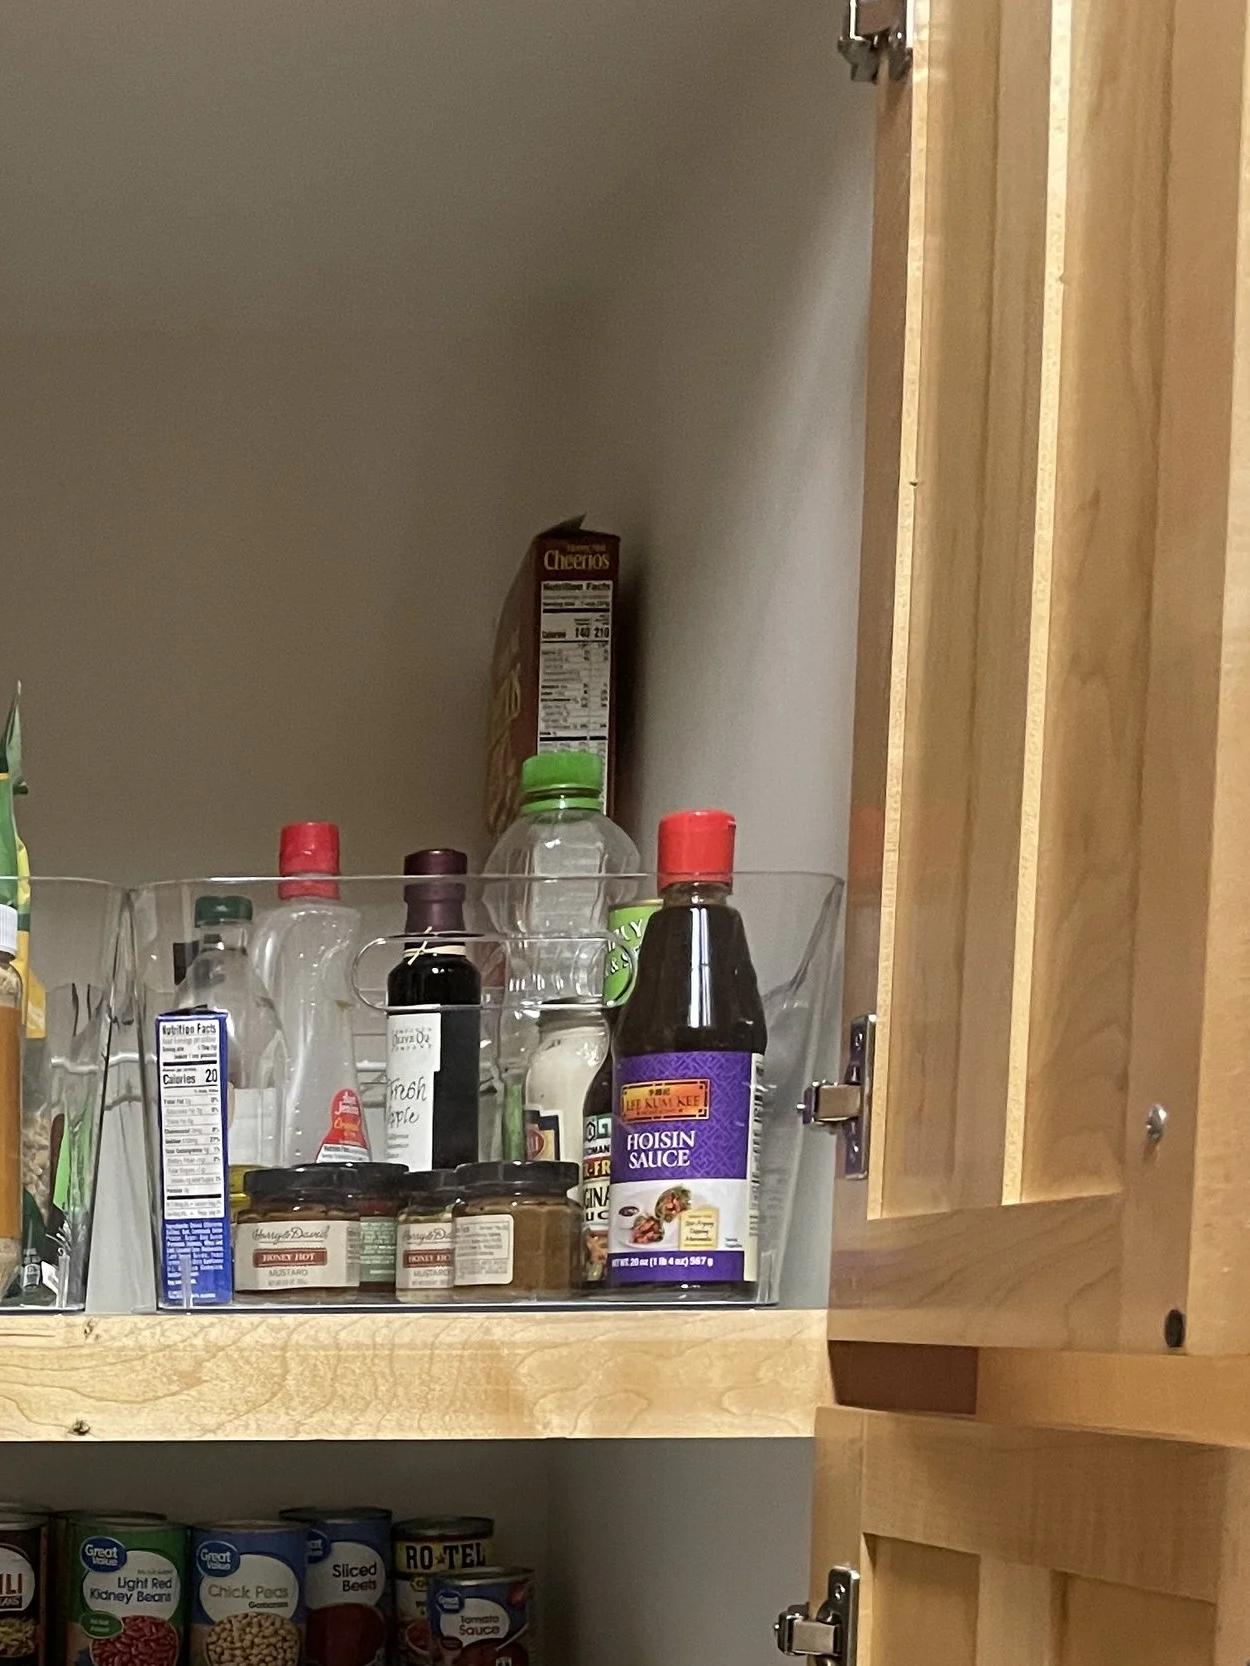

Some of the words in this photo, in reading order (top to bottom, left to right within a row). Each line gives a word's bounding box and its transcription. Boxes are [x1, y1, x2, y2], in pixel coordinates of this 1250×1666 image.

[544, 550, 610, 570] Cheerios
[162, 1024, 195, 1036] Nutrition
[197, 1023, 217, 1034] Facts
[163, 1074, 196, 1085] Calories
[205, 1069, 218, 1082] 20
[626, 1099, 641, 1111] LEE
[645, 1098, 671, 1108] KUM
[677, 1096, 700, 1107] KEE
[627, 1131, 696, 1152] HOISIN
[629, 1151, 690, 1169] SAUCE
[263, 1254, 293, 1262] HONEY
[295, 1253, 316, 1261] HOT
[630, 1258, 639, 1266] 20
[650, 1258, 657, 1267] (1
[675, 1258, 688, 1266] oz)
[690, 1257, 707, 1265] 567
[707, 1258, 713, 1267] g
[84, 1543, 119, 1560] Great
[200, 1549, 231, 1563] Great
[405, 1545, 433, 1570] RO
[443, 1543, 486, 1569] TEL
[92, 1557, 118, 1567] Value
[206, 1561, 231, 1570] Value
[333, 1563, 377, 1577] Sliced
[118, 1576, 148, 1591] Light
[151, 1576, 172, 1589] Red
[342, 1580, 377, 1591] Beets
[90, 1588, 132, 1604] Kidney
[136, 1590, 172, 1603] Beans
[208, 1584, 250, 1598] Chick
[256, 1585, 289, 1599] Peas
[460, 1616, 500, 1624] Tomato
[459, 1624, 500, 1636] Sauce
